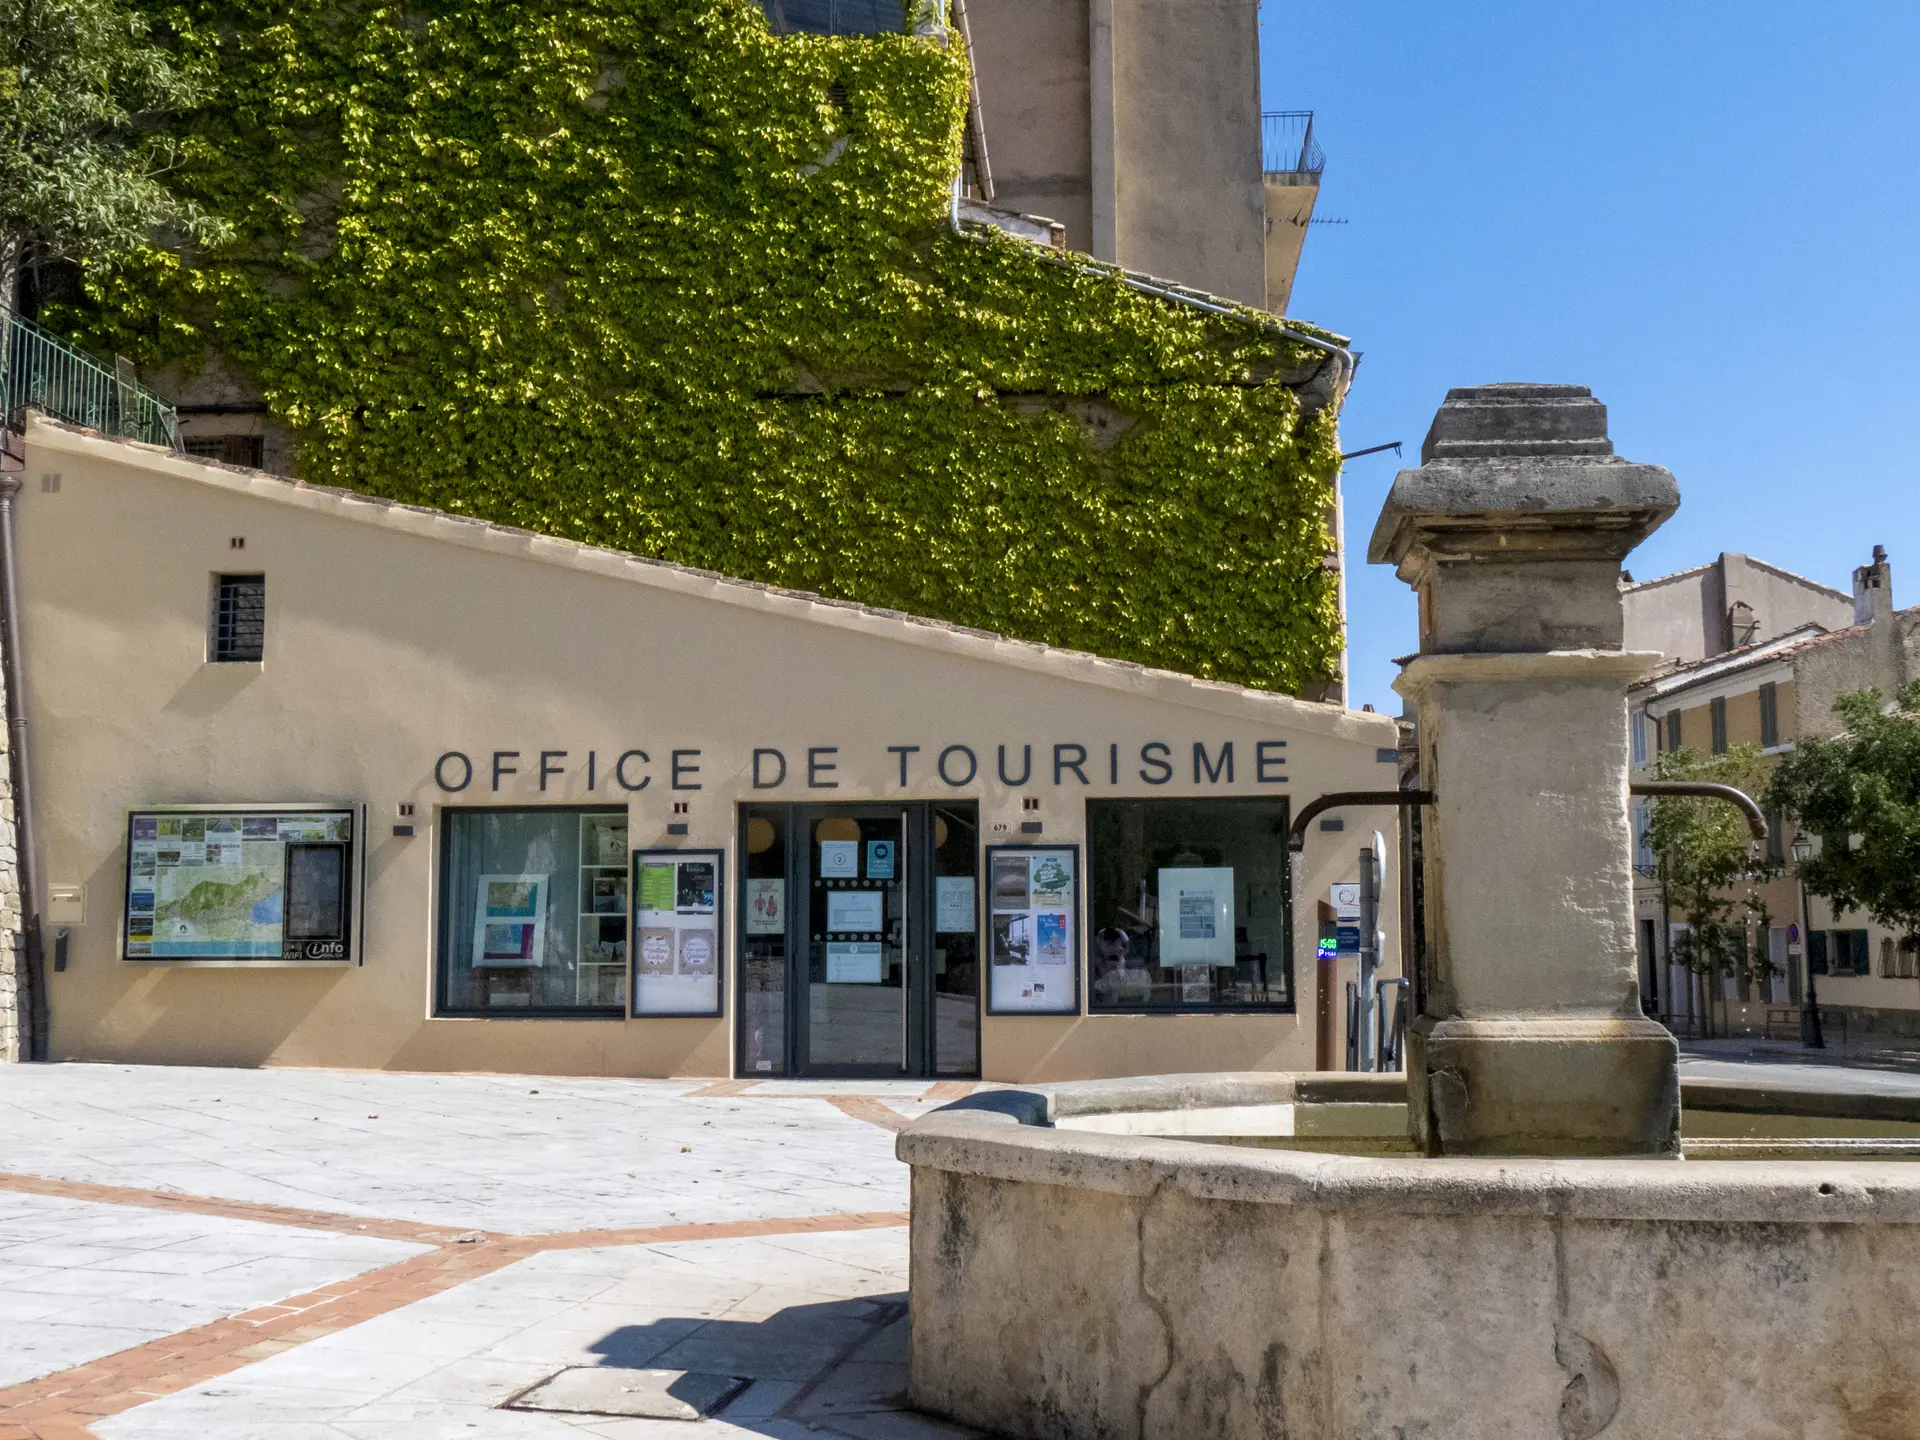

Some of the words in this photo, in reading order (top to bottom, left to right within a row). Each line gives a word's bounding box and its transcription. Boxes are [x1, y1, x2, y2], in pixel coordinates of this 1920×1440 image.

[434, 750, 702, 793] OFFICE
[752, 746, 839, 790] DE
[887, 740, 1289, 788] TOURISME
[993, 823, 1007, 832] 679
[1318, 949, 1324, 957] P
